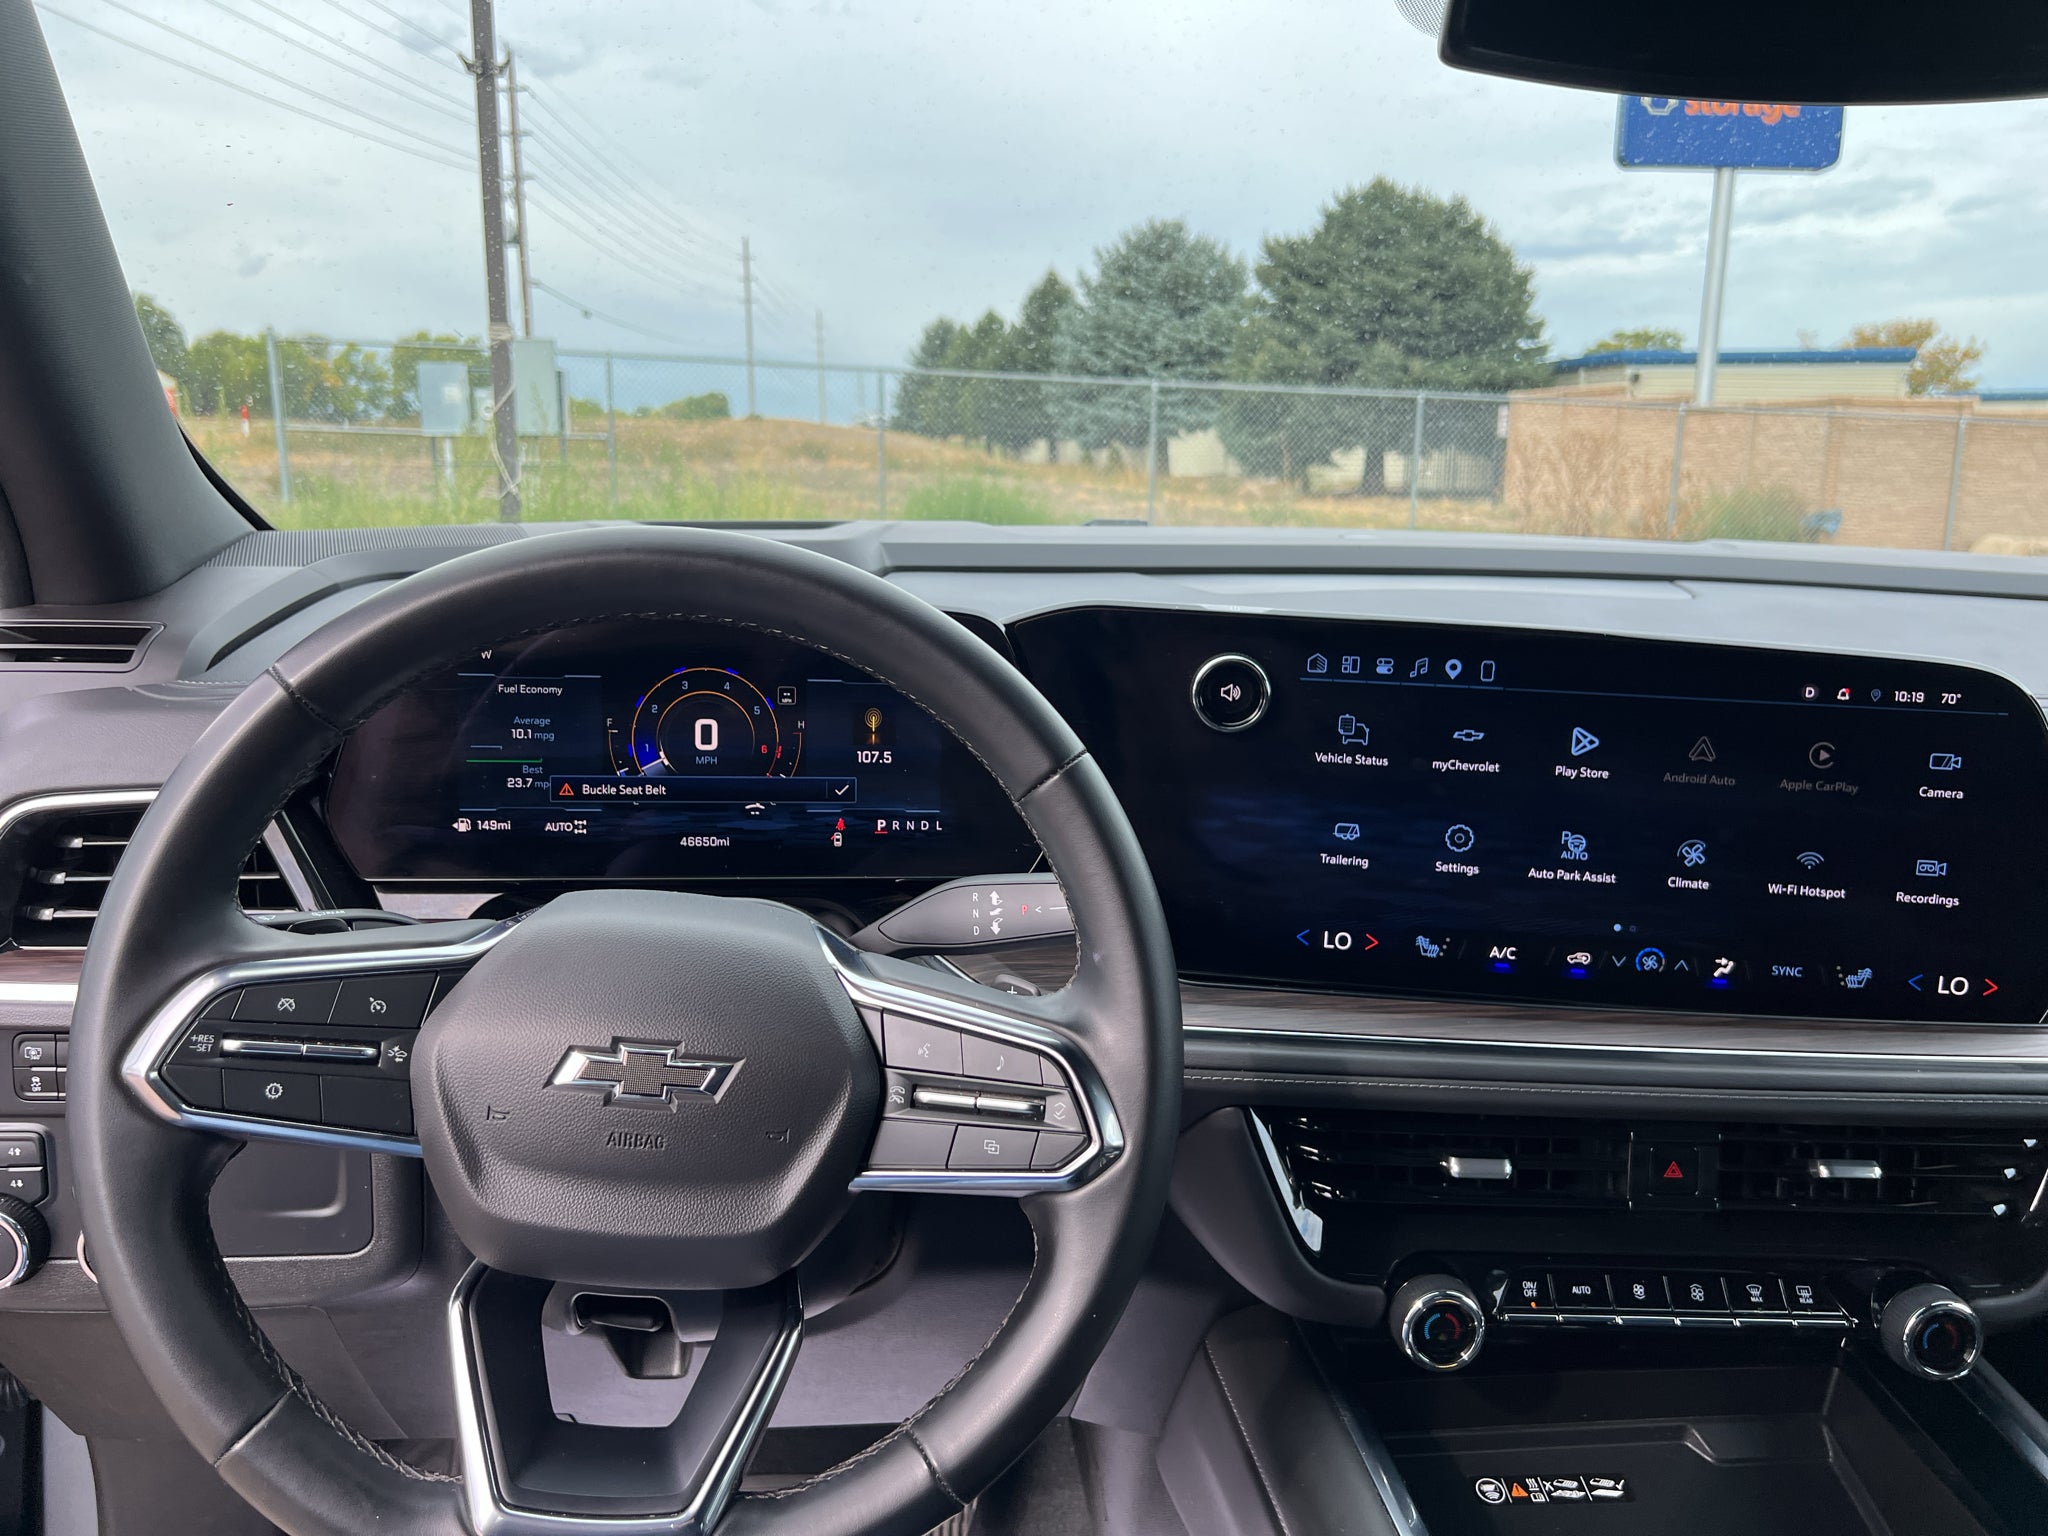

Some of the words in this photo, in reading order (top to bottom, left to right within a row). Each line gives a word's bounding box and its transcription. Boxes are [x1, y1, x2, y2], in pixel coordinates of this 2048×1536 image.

[1684, 100, 1801, 125] storage
[498, 684, 518, 694] Fuel
[520, 685, 563, 696] Economy
[681, 680, 689, 690] 3
[723, 681, 731, 692] 4
[1894, 690, 1925, 704] 10:19
[1941, 692, 1962, 705] 70°
[651, 704, 659, 714] 2
[753, 705, 761, 716] 5
[513, 716, 551, 727] Average
[606, 717, 613, 727] F
[797, 720, 805, 730] H
[511, 729, 533, 740] 10.1
[534, 732, 555, 742] mpg
[694, 718, 719, 751] 0
[761, 744, 768, 755] 6
[695, 756, 718, 765] MPH
[857, 751, 893, 764] 107.5
[1314, 752, 1352, 766] Vehicle
[1354, 754, 1389, 767] Status
[522, 765, 543, 774] Best
[1432, 759, 1500, 774] myChevrolet
[1555, 766, 1578, 780] Play
[1580, 767, 1609, 779] Store
[507, 777, 533, 788] 23.7
[534, 781, 551, 790] mp
[1663, 772, 1707, 785] Android
[1709, 775, 1736, 786] Auto
[582, 784, 616, 795] Buckle
[619, 784, 642, 795] Seat
[645, 784, 666, 795] Belt
[1779, 779, 1812, 792] Apple
[1816, 781, 1859, 794] CarPlay
[1919, 786, 1964, 799] Camera
[477, 821, 511, 830] 149mi
[545, 822, 573, 832] AUTO
[877, 819, 886, 830] P
[892, 821, 900, 830] R
[907, 821, 915, 830] N
[921, 821, 929, 830] D
[936, 821, 942, 830] L
[680, 836, 730, 847] 46650mi
[1320, 853, 1369, 869] Trailering
[1561, 850, 1588, 861] AUTO
[1435, 861, 1479, 875] Settings
[1528, 868, 1553, 880] Auto
[1557, 870, 1581, 881] Park
[1583, 871, 1616, 883] Assist
[1667, 877, 1709, 890] Climate
[1768, 883, 1797, 895] Wi-Fi
[1800, 885, 1846, 899] Hotspot
[972, 892, 978, 902] R
[1896, 892, 1960, 907] Recordings
[972, 908, 979, 919] N
[1021, 904, 1028, 915] P
[973, 926, 980, 936] D
[1323, 931, 1352, 950] LO
[1489, 946, 1517, 960] A/C
[1771, 965, 1803, 977] SYNC
[1938, 976, 1969, 996] LO
[606, 1131, 666, 1150] AIRBAG
[8, 1148, 14, 1156] 4
[10, 1180, 17, 1188] 4
[1522, 1281, 1537, 1289] ON/
[1572, 1286, 1591, 1295] AUTO
[1523, 1289, 1537, 1297] OFF
